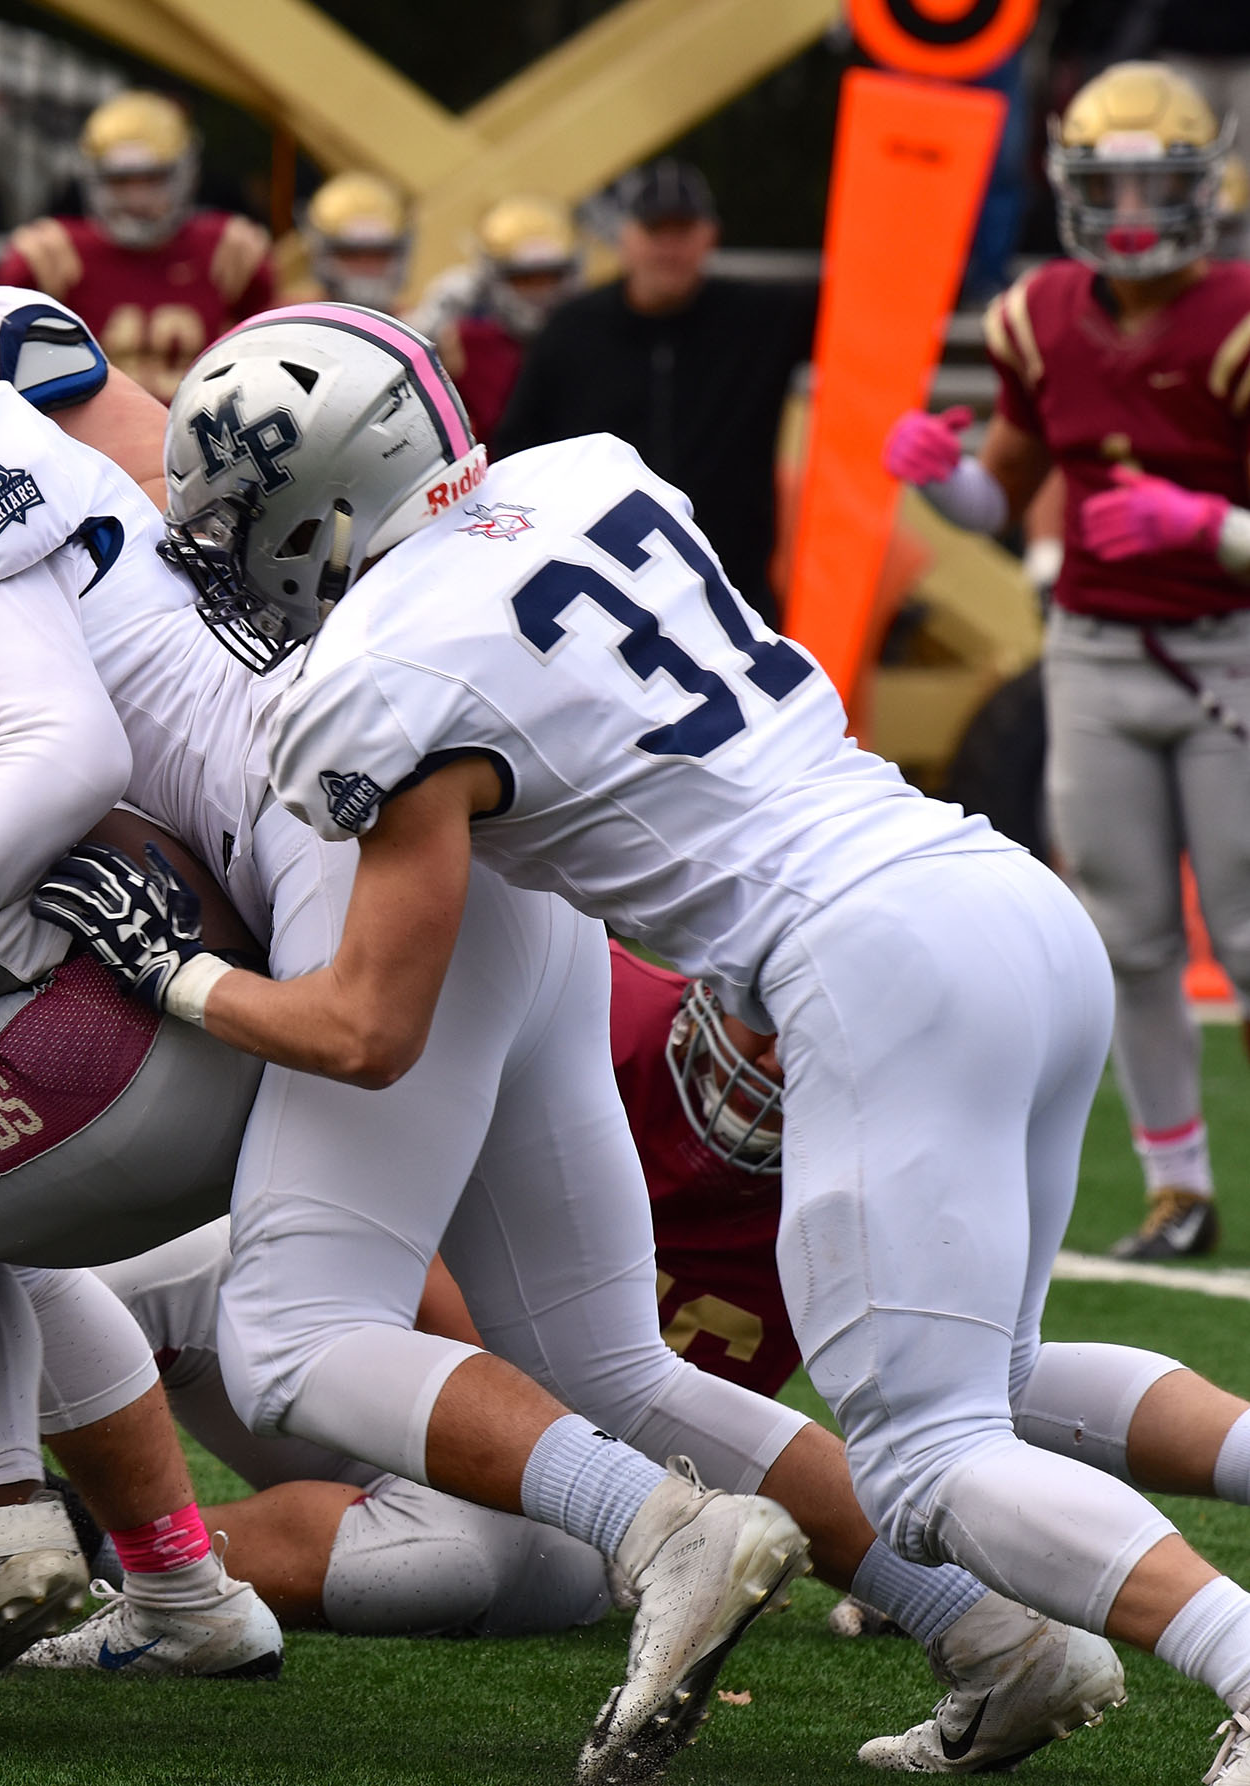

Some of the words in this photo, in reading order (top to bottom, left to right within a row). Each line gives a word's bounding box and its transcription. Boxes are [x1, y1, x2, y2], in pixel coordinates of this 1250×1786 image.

[187, 385, 305, 498] MP
[506, 487, 816, 762] 37
[335, 779, 376, 828] FRIARS
